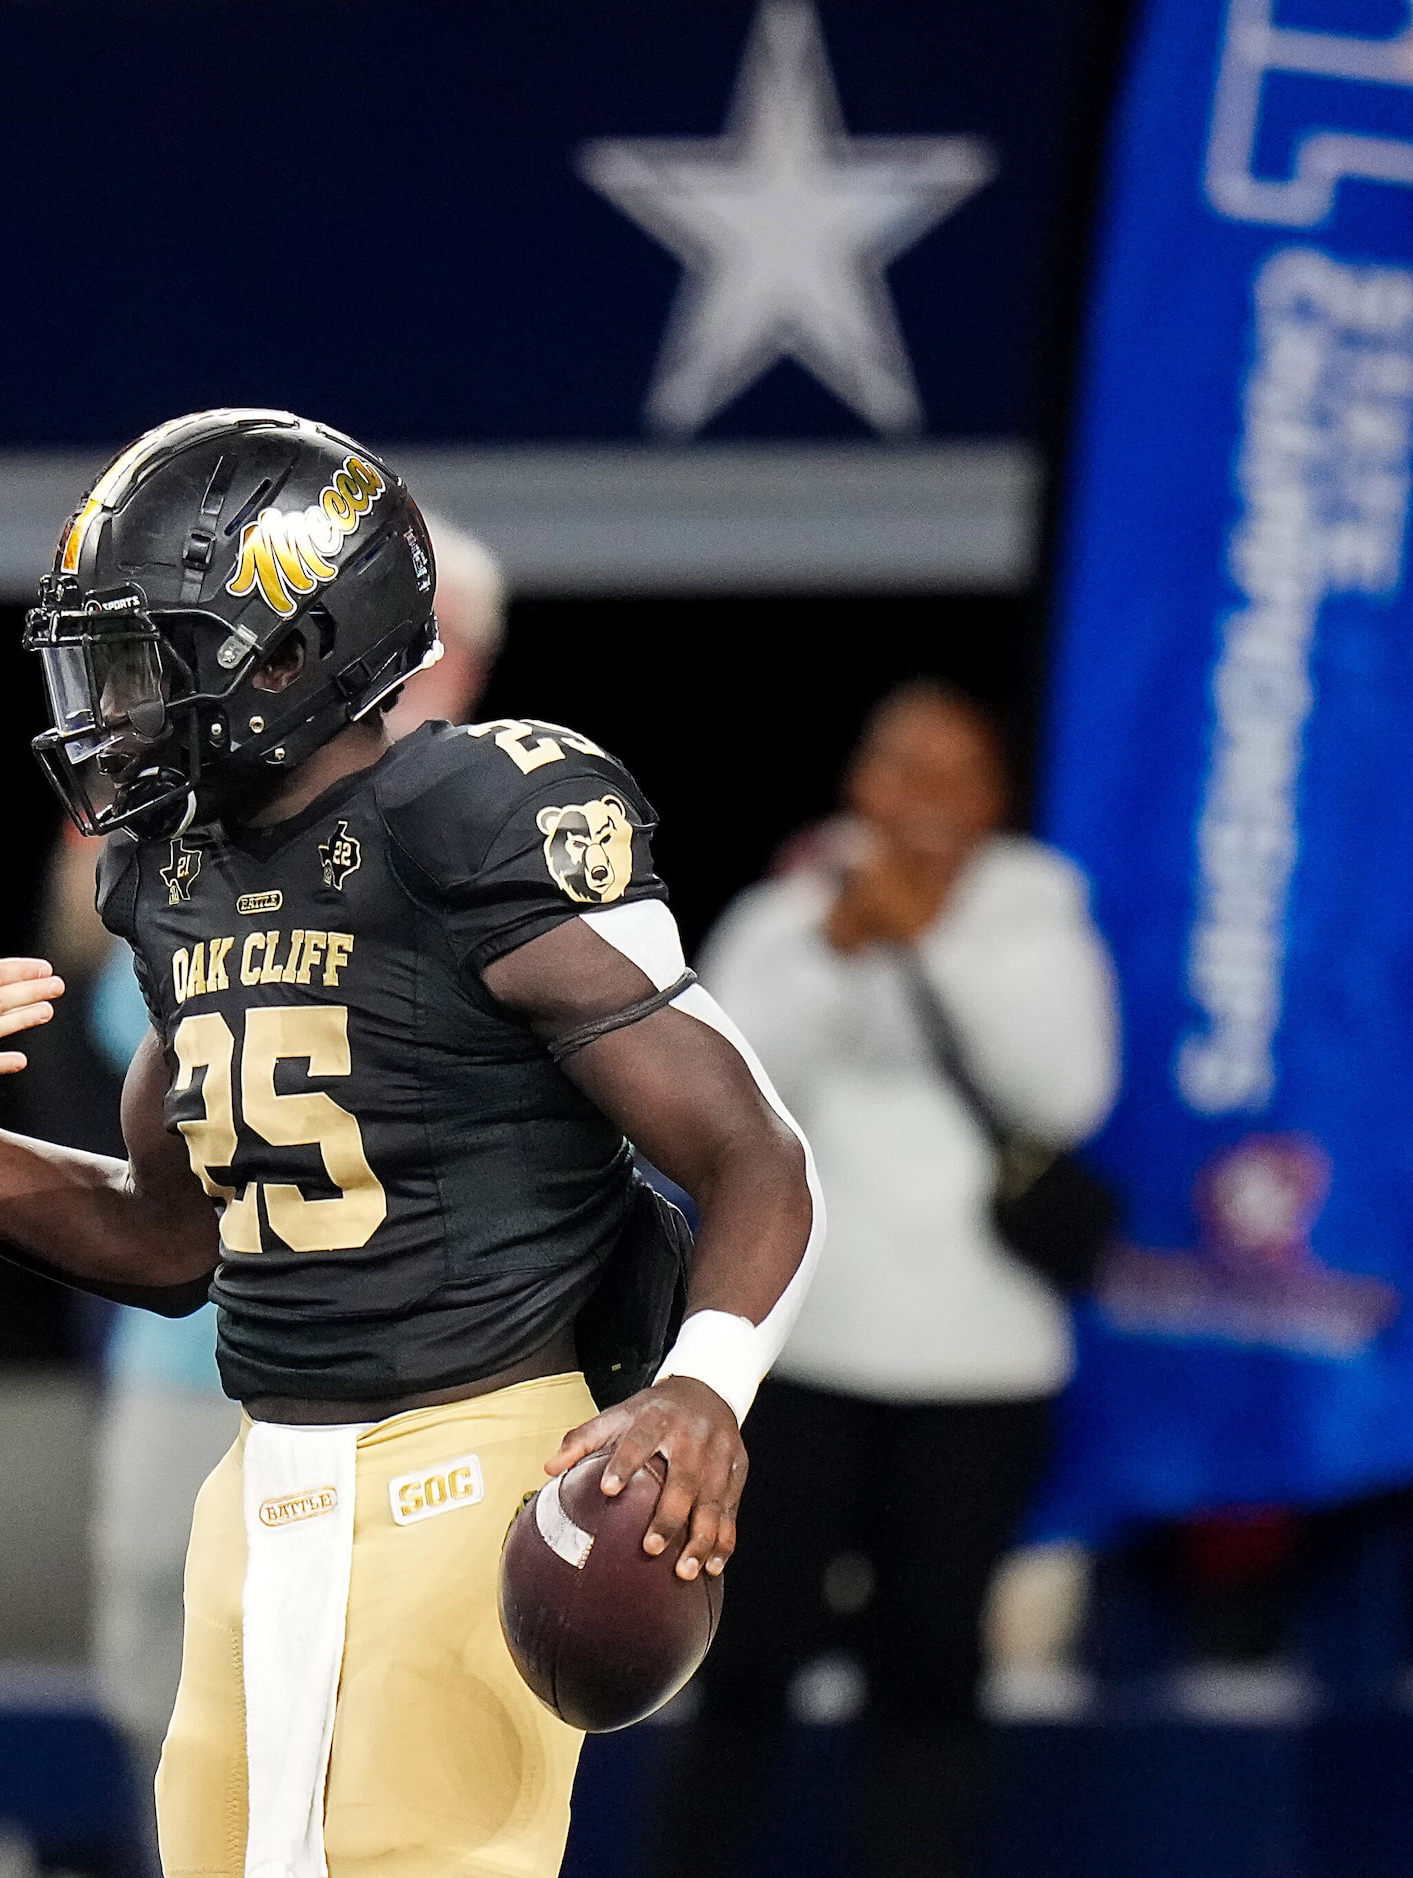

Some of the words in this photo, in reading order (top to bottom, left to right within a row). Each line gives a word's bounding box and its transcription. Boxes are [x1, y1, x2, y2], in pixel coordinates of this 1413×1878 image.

[224, 455, 387, 617] Mecca
[102, 595, 141, 611] SPORTS
[176, 854, 191, 878] 21
[333, 840, 352, 867] 22
[241, 894, 278, 911] BATTLE
[172, 936, 235, 1005] OAK
[240, 929, 355, 987] CLIFF
[174, 1005, 387, 1254] 25
[399, 1466, 474, 1517] SOC
[266, 1493, 332, 1522] BATTLE
